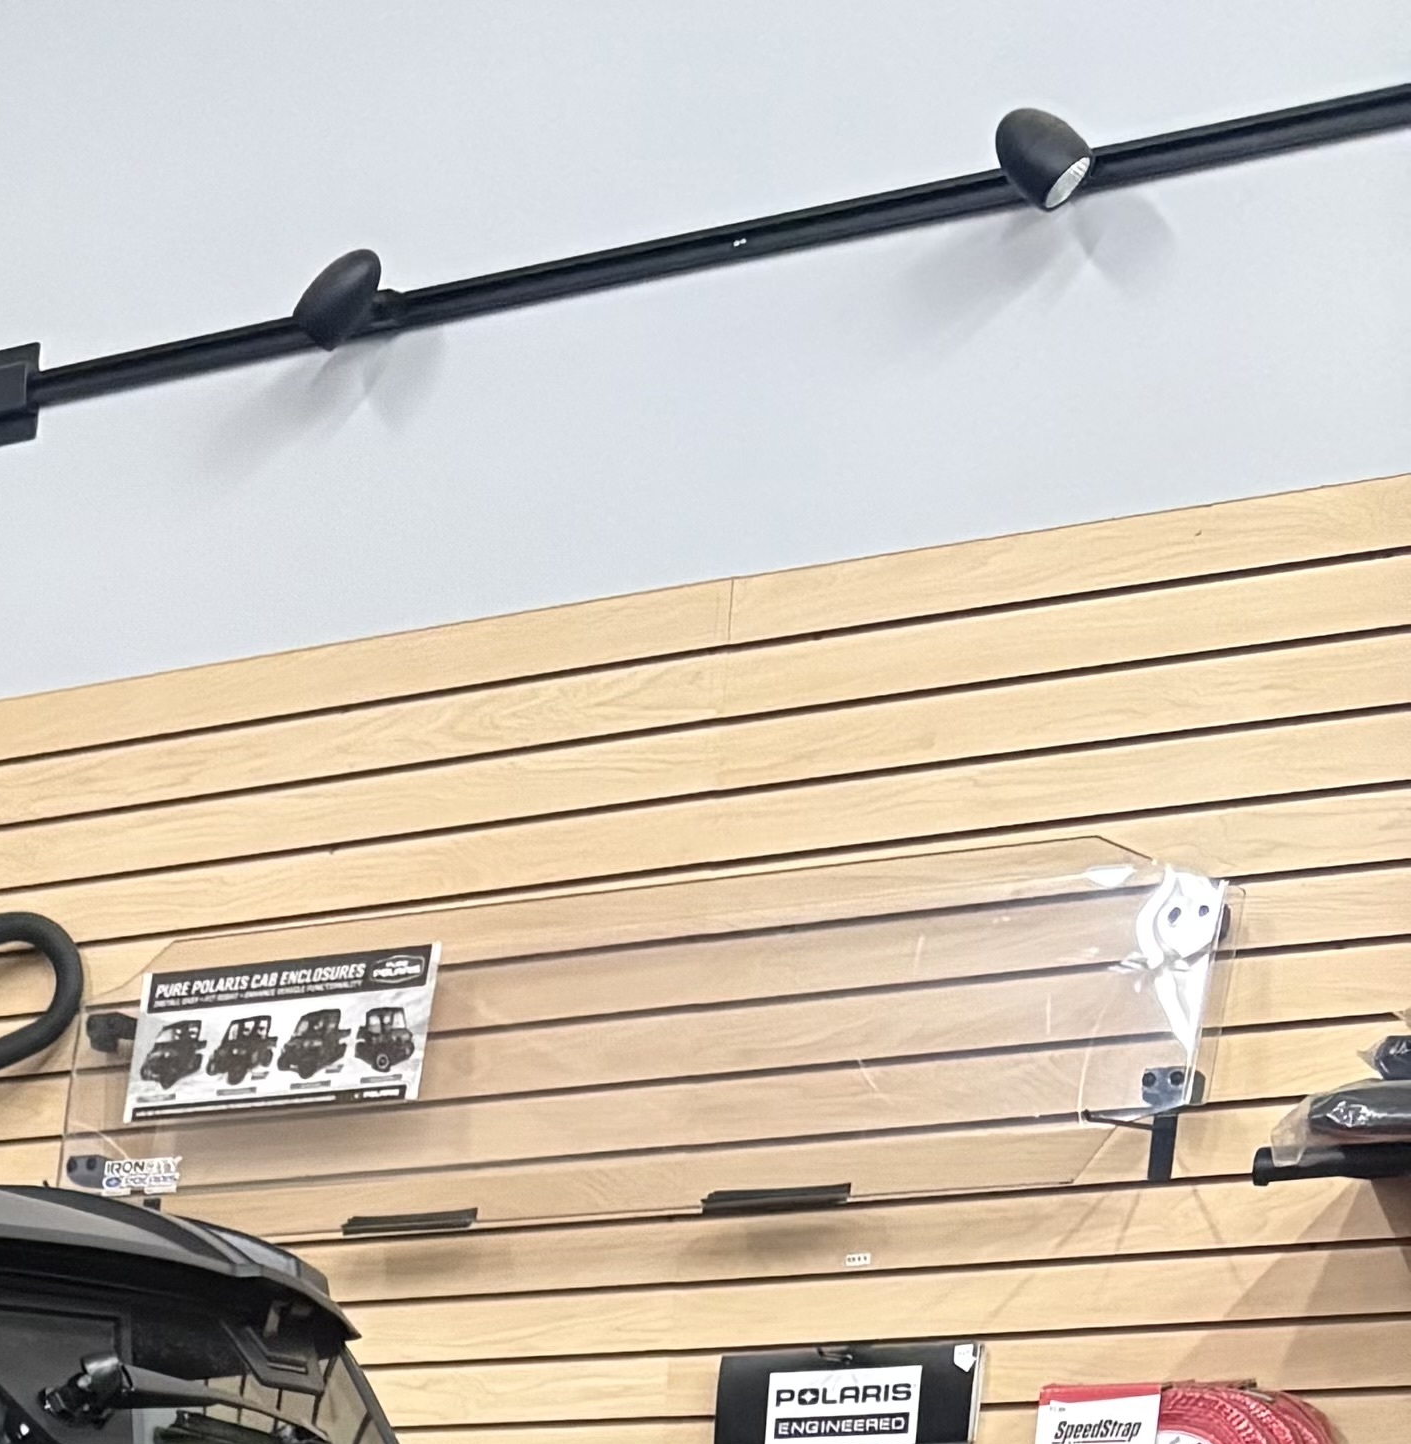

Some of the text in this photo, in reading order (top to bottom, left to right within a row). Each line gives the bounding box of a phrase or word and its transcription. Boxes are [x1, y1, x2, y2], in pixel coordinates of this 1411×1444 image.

[155, 963, 366, 999] PURE POLARIS CAB ENCLOSURES
[106, 1161, 145, 1174] IRON
[776, 1383, 912, 1407] POLARIS
[778, 1416, 905, 1436] ENGINEERED
[1054, 1420, 1142, 1442] SpeedStrap
